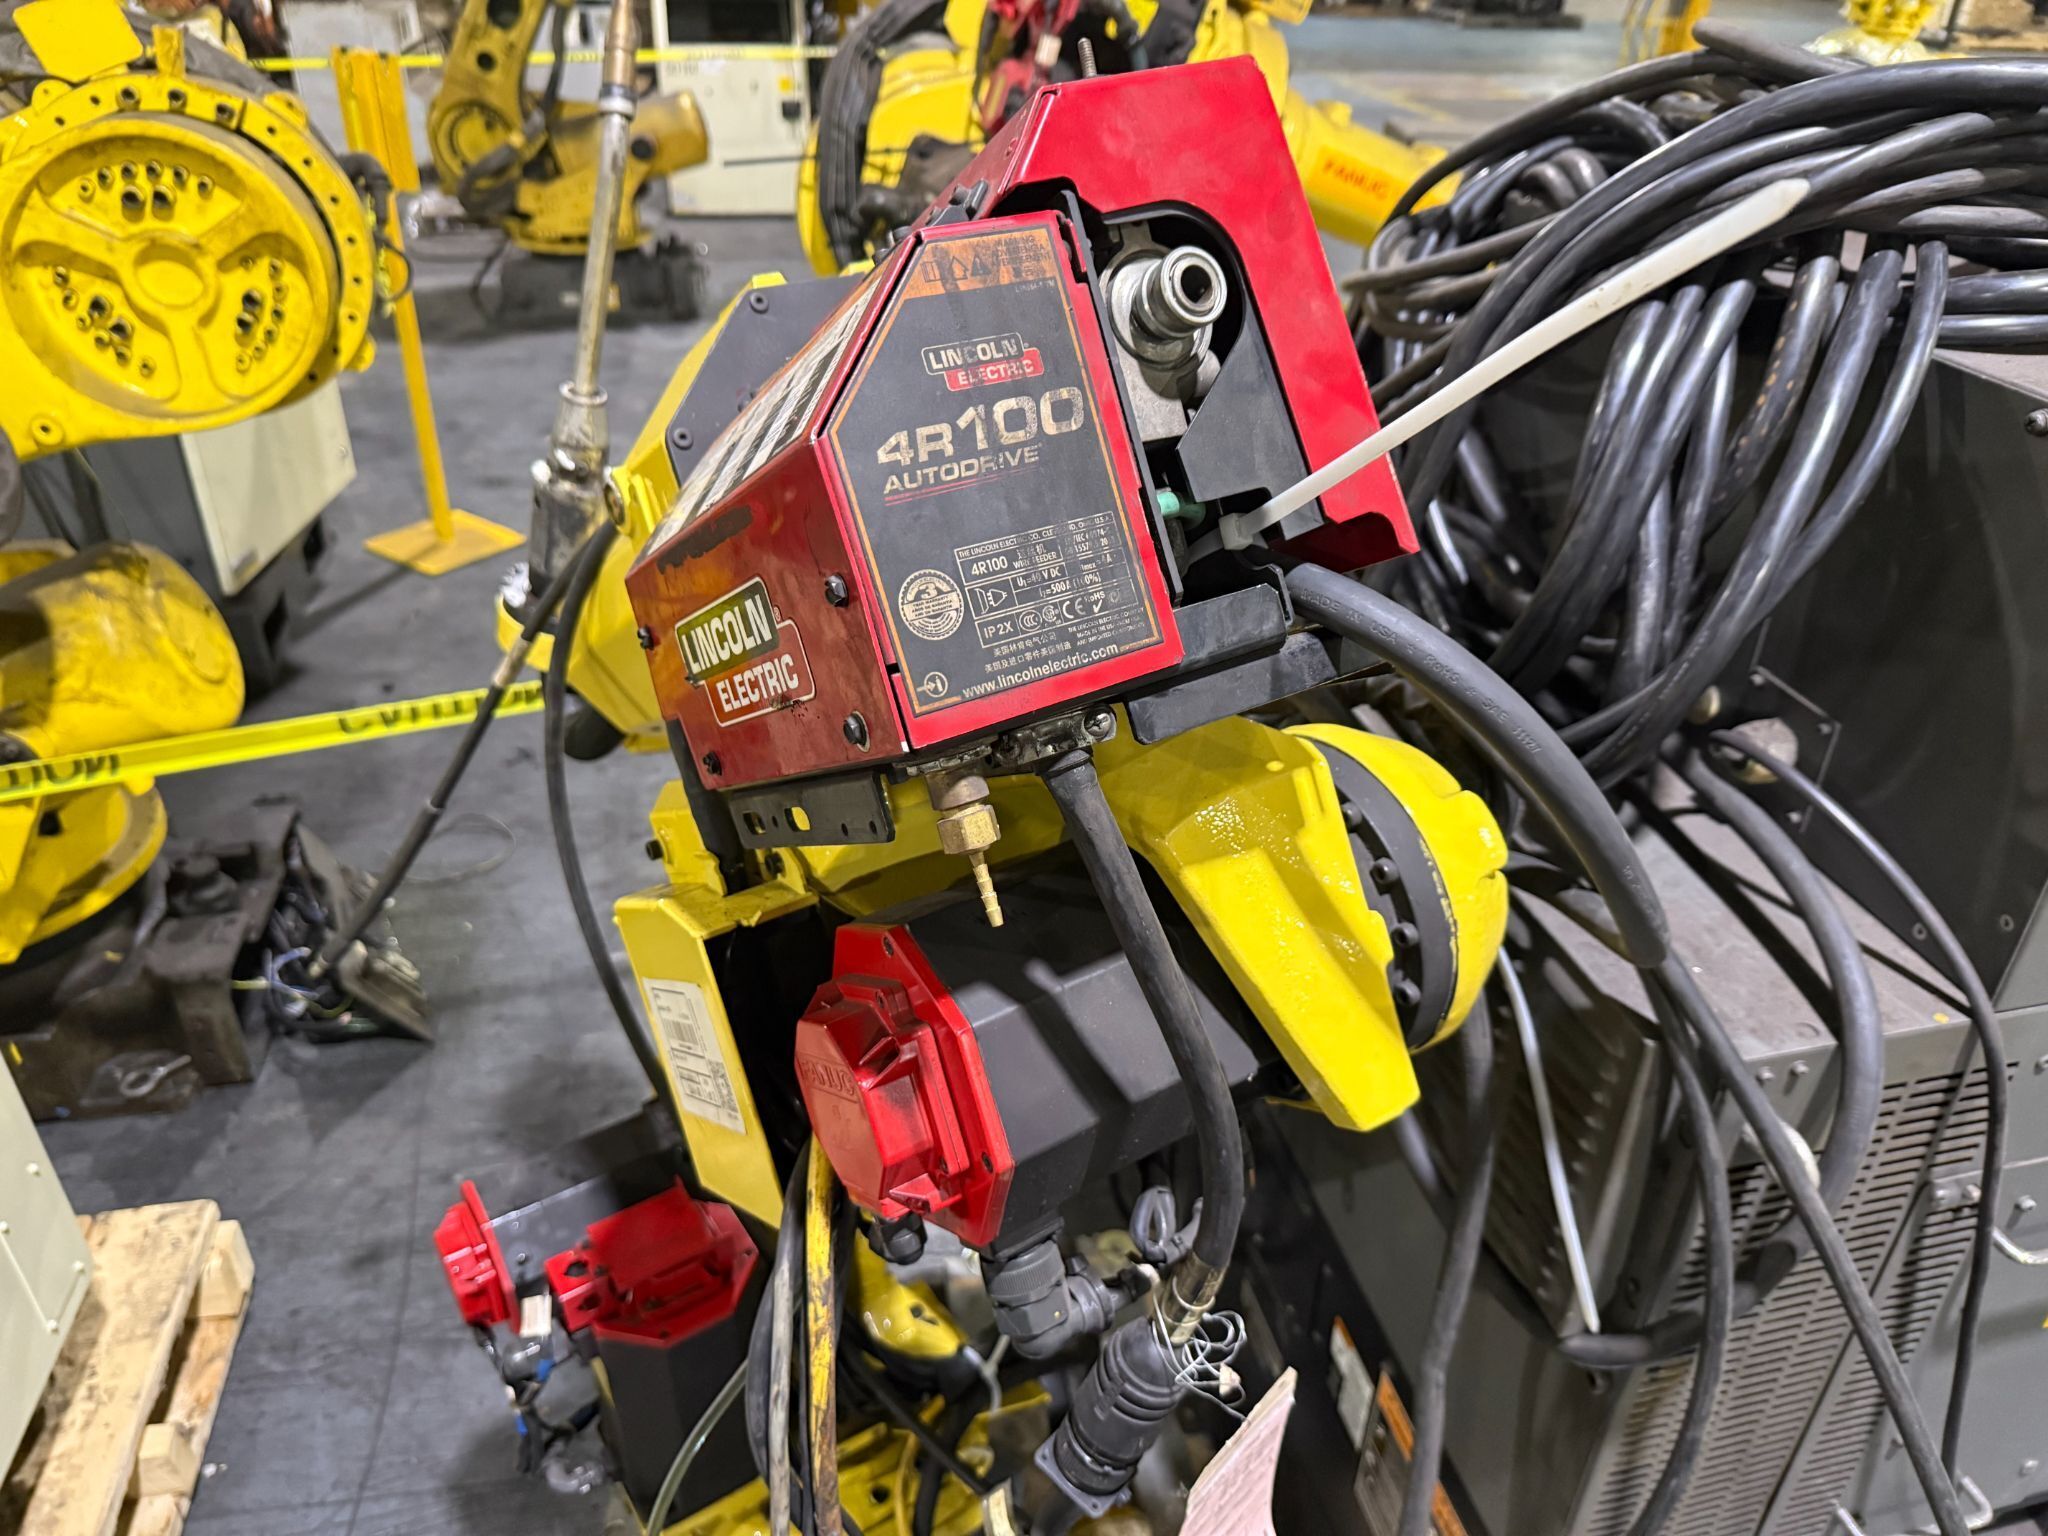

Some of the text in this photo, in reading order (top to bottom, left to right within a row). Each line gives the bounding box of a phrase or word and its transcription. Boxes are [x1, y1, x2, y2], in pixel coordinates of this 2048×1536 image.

[929, 338, 1018, 370] LINCOLN
[957, 359, 1034, 385] ELECTRIC
[876, 386, 1085, 467] 4R100
[883, 446, 1040, 494] AUTODRIVE
[958, 549, 970, 558] THE
[970, 541, 1000, 555] LINCOLN
[971, 555, 1008, 576] 4R100
[1041, 569, 1049, 579] V
[1049, 566, 1061, 578] DC
[681, 594, 773, 675] LINCOLN
[715, 653, 799, 713] ELECTRIC
[962, 644, 1119, 698] www.lincolnelectric.com
